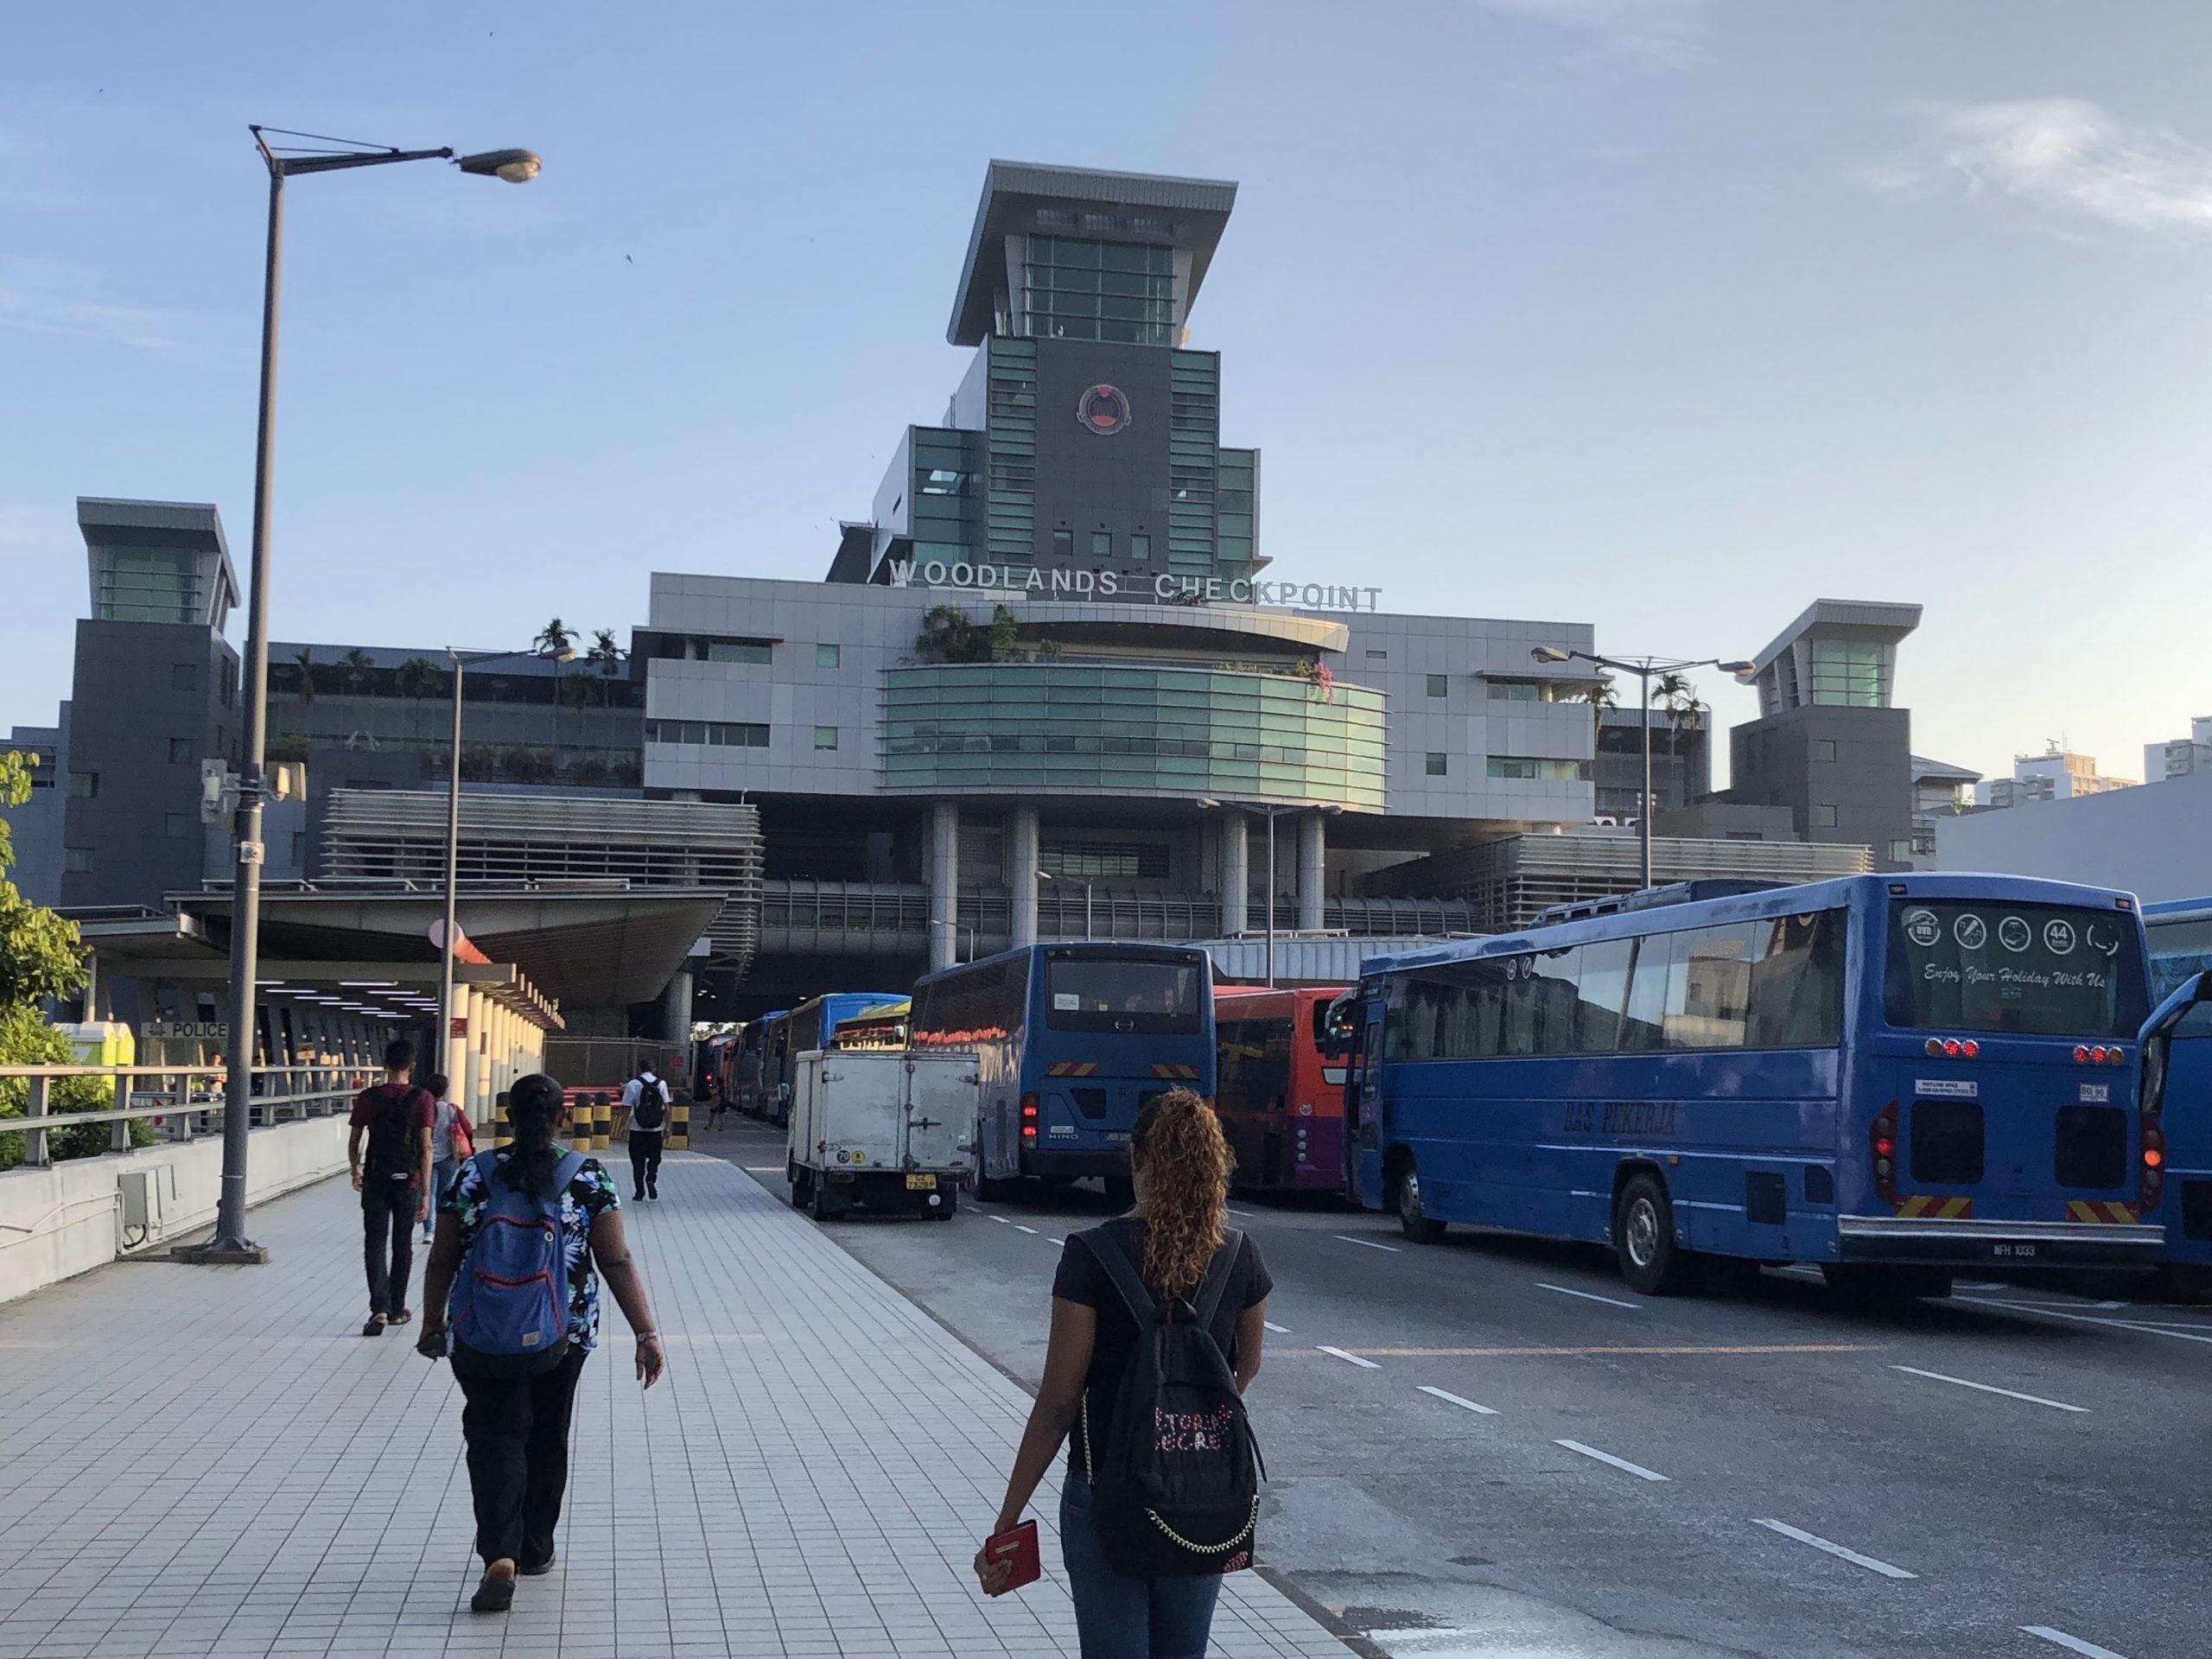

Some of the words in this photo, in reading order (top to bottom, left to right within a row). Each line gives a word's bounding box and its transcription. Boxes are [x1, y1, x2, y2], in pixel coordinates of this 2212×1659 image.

[889, 558, 1118, 596] WOODLANDS
[1154, 573, 1383, 611] CHECKPOINT
[2050, 925, 2068, 939] 44
[1923, 963, 1960, 982] Enjoy
[1965, 965, 1996, 984] Your
[1998, 967, 2050, 988] Holiday
[2052, 970, 2083, 987] With
[2086, 972, 2106, 988] Us
[173, 1023, 227, 1037] POLICE
[839, 1151, 849, 1161] 70
[2014, 1244, 2036, 1256] 1033
